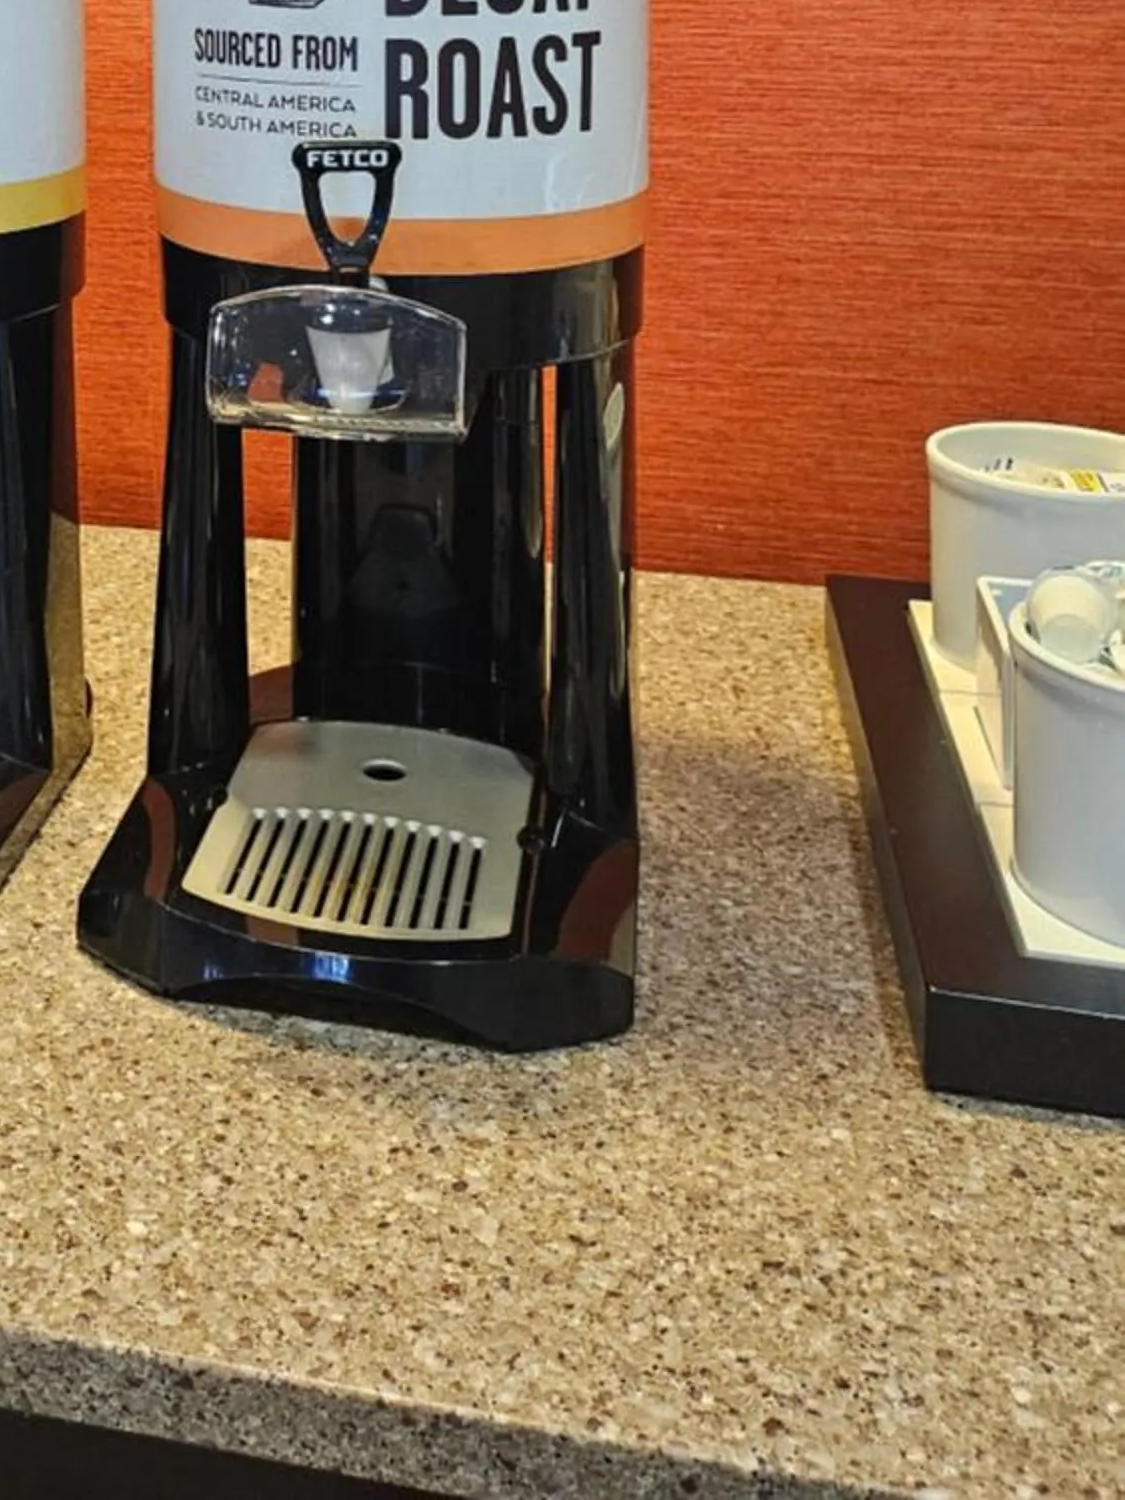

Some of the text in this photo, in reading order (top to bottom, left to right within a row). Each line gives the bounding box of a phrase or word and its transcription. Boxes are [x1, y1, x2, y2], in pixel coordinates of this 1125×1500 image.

[194, 28, 358, 72] SOURCED FROM
[195, 85, 356, 113] CENTRAL AMERICA
[384, 31, 602, 141] ROAST
[208, 111, 262, 132] SOUTH
[266, 120, 357, 138] AMERICA
[306, 150, 389, 168] FETCO
